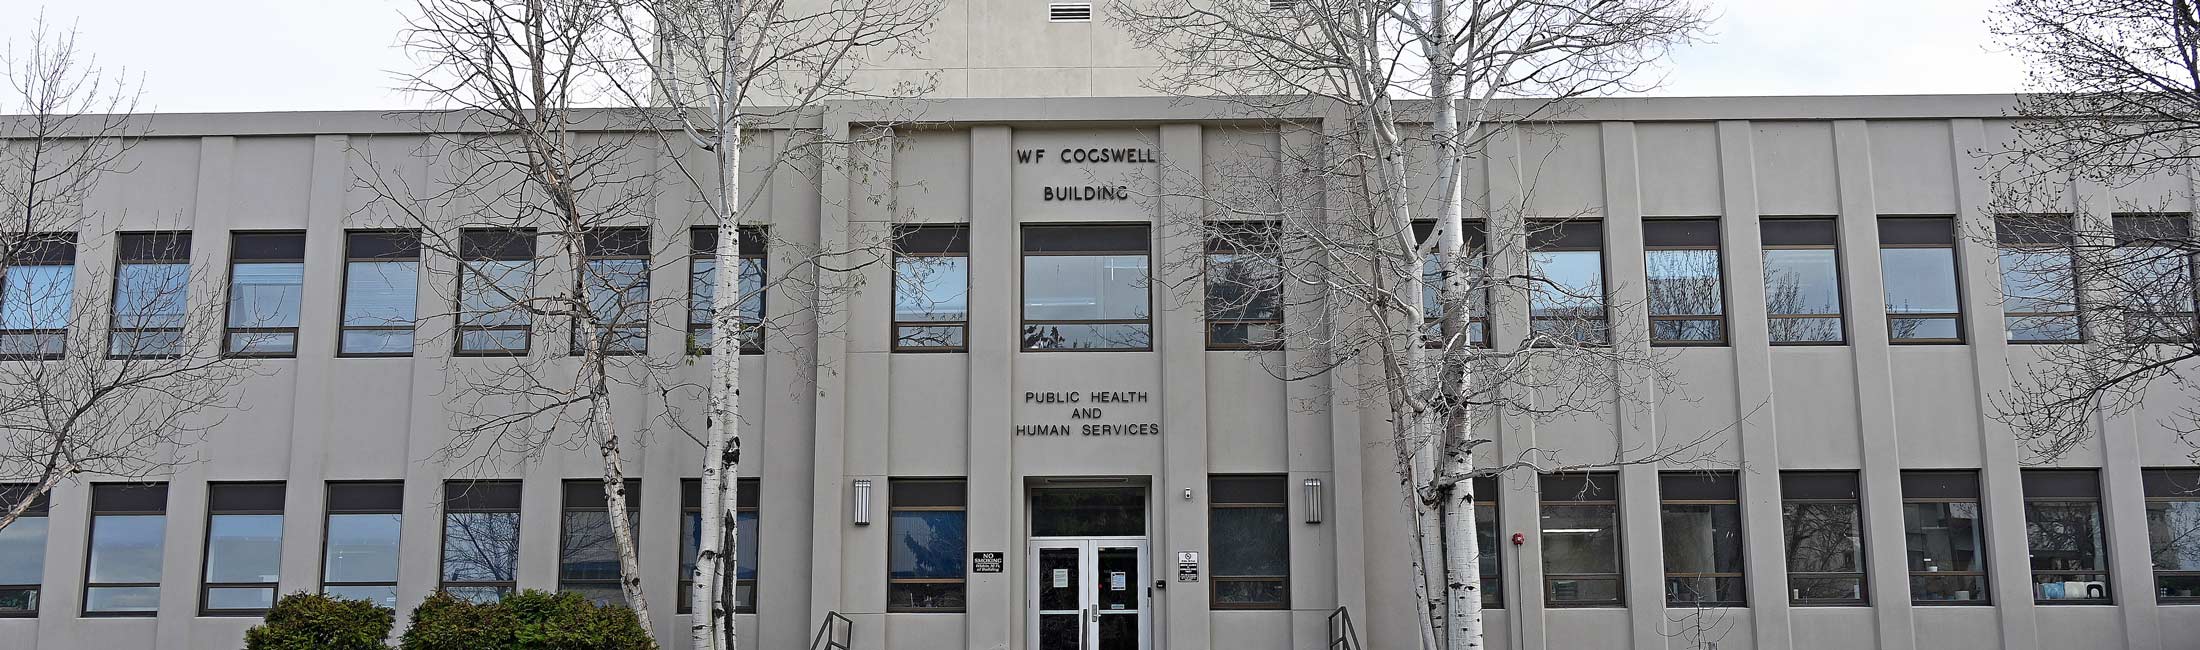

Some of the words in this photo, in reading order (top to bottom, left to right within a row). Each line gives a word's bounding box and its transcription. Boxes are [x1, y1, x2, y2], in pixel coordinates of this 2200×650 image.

[1017, 149, 1045, 163] WF
[1060, 148, 1156, 163] COGSWELL
[1044, 186, 1128, 201] BUILDING
[1025, 391, 1080, 403] PUBLIC
[1091, 391, 1148, 403] HEALTH
[1071, 407, 1102, 419] AND
[1016, 424, 1070, 436] HUMAN
[1082, 423, 1159, 436] SERVICES
